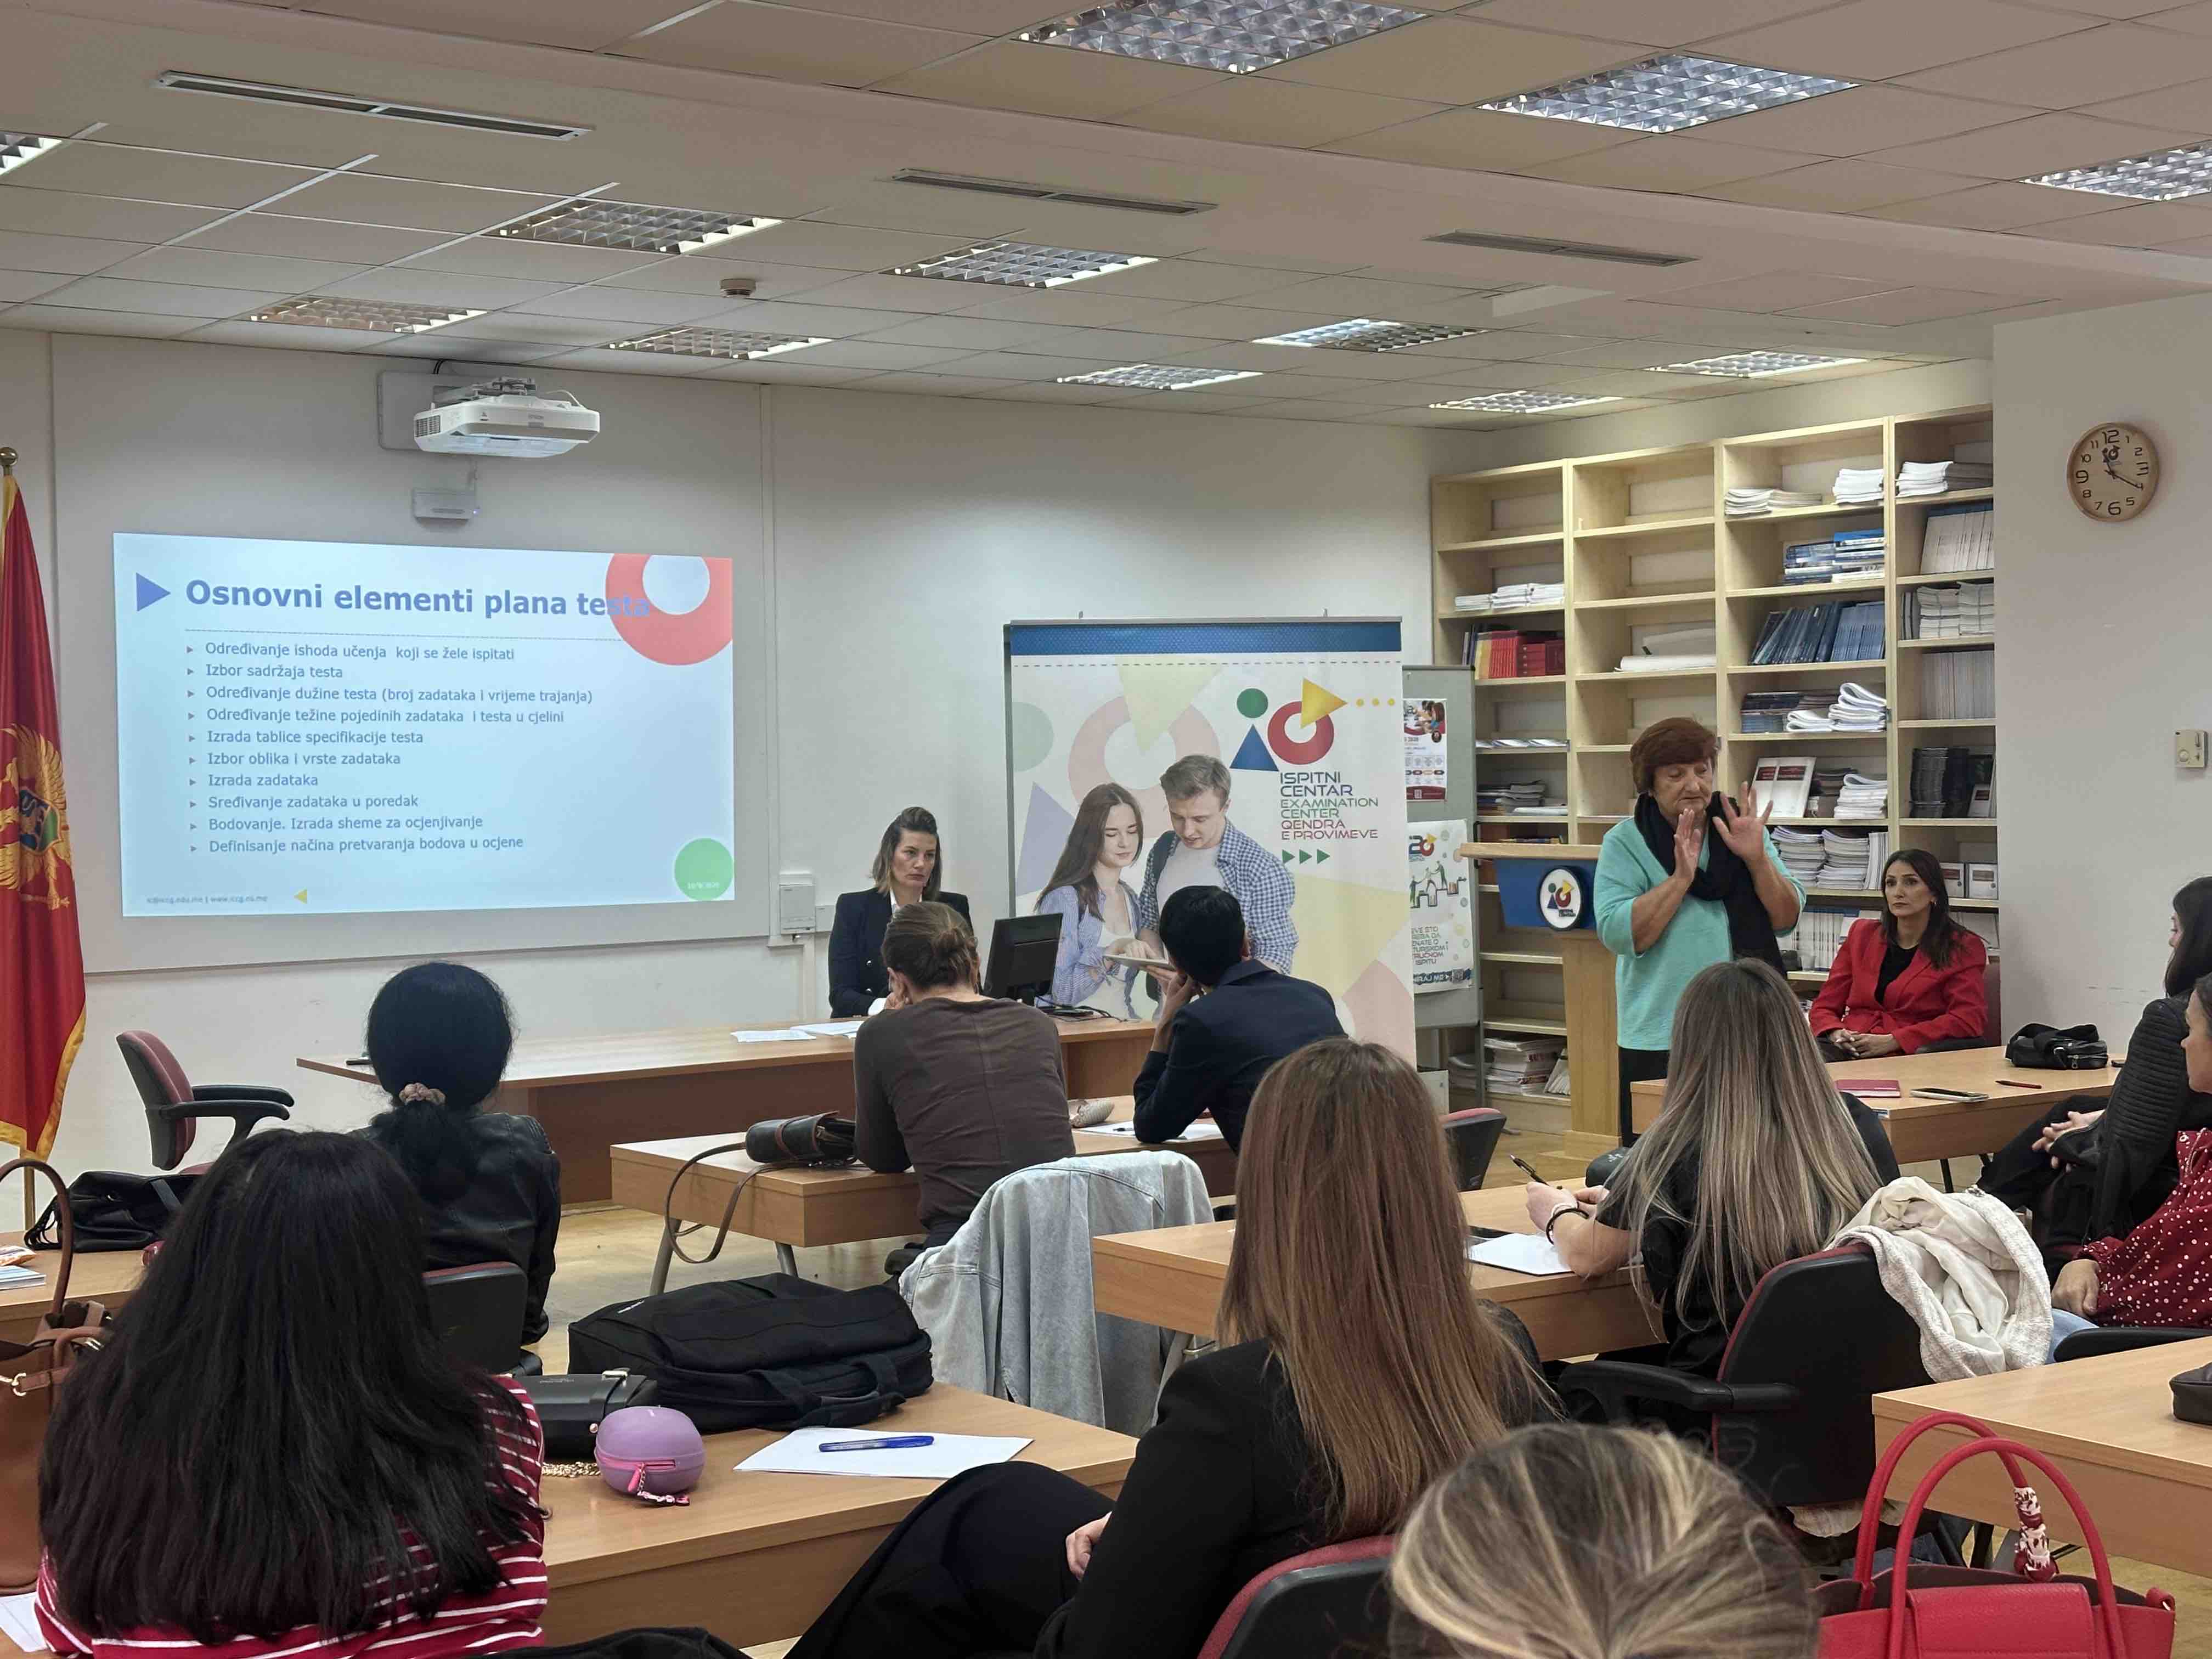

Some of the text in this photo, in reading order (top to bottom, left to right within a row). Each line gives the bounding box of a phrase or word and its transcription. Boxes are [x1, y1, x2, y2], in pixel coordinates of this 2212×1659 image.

[2102, 430, 2120, 444] 12
[2091, 441, 2098, 449] 11
[2135, 447, 2142, 456] 2
[2081, 454, 2091, 462] 10
[2136, 462, 2149, 476] 3
[2075, 470, 2089, 483] 9
[2083, 489, 2091, 498] 8
[2095, 501, 2103, 510] 7
[2126, 497, 2134, 506] 5
[2107, 501, 2121, 516] 6
[186, 579, 650, 619] Osnovni elementi plana testa
[206, 642, 514, 662] Određivanje ishoda učenja koji se žele ispitati
[206, 664, 343, 680] Izbor sadržaja testa
[206, 686, 592, 705] Određivanje dužine testa (broj zadataka i vrijeme trajanja)
[207, 708, 564, 725] Određivanje težine pojedinih zadataka i testa u cjelini
[207, 730, 423, 746] Izrada tablice specifikacije testa
[208, 752, 401, 764] Izbor oblika i vrste zadataka
[208, 774, 318, 786] Izrada zadataka
[1280, 772, 1341, 784] ISPITNI
[1280, 785, 1353, 797] CENTAR
[208, 794, 419, 811] Sređivanje zadataka u poredak
[1281, 798, 1379, 808] EXAMINATION
[1281, 808, 1339, 819] CENTER
[209, 816, 483, 833] Bodovanje. Izrada sheme za ocjenjivanje
[1282, 819, 1346, 830] QENDRA
[1282, 829, 1378, 840] E PROVIMEVE
[210, 836, 524, 855] Definisanje načina pretvaranja bodova u ocjene
